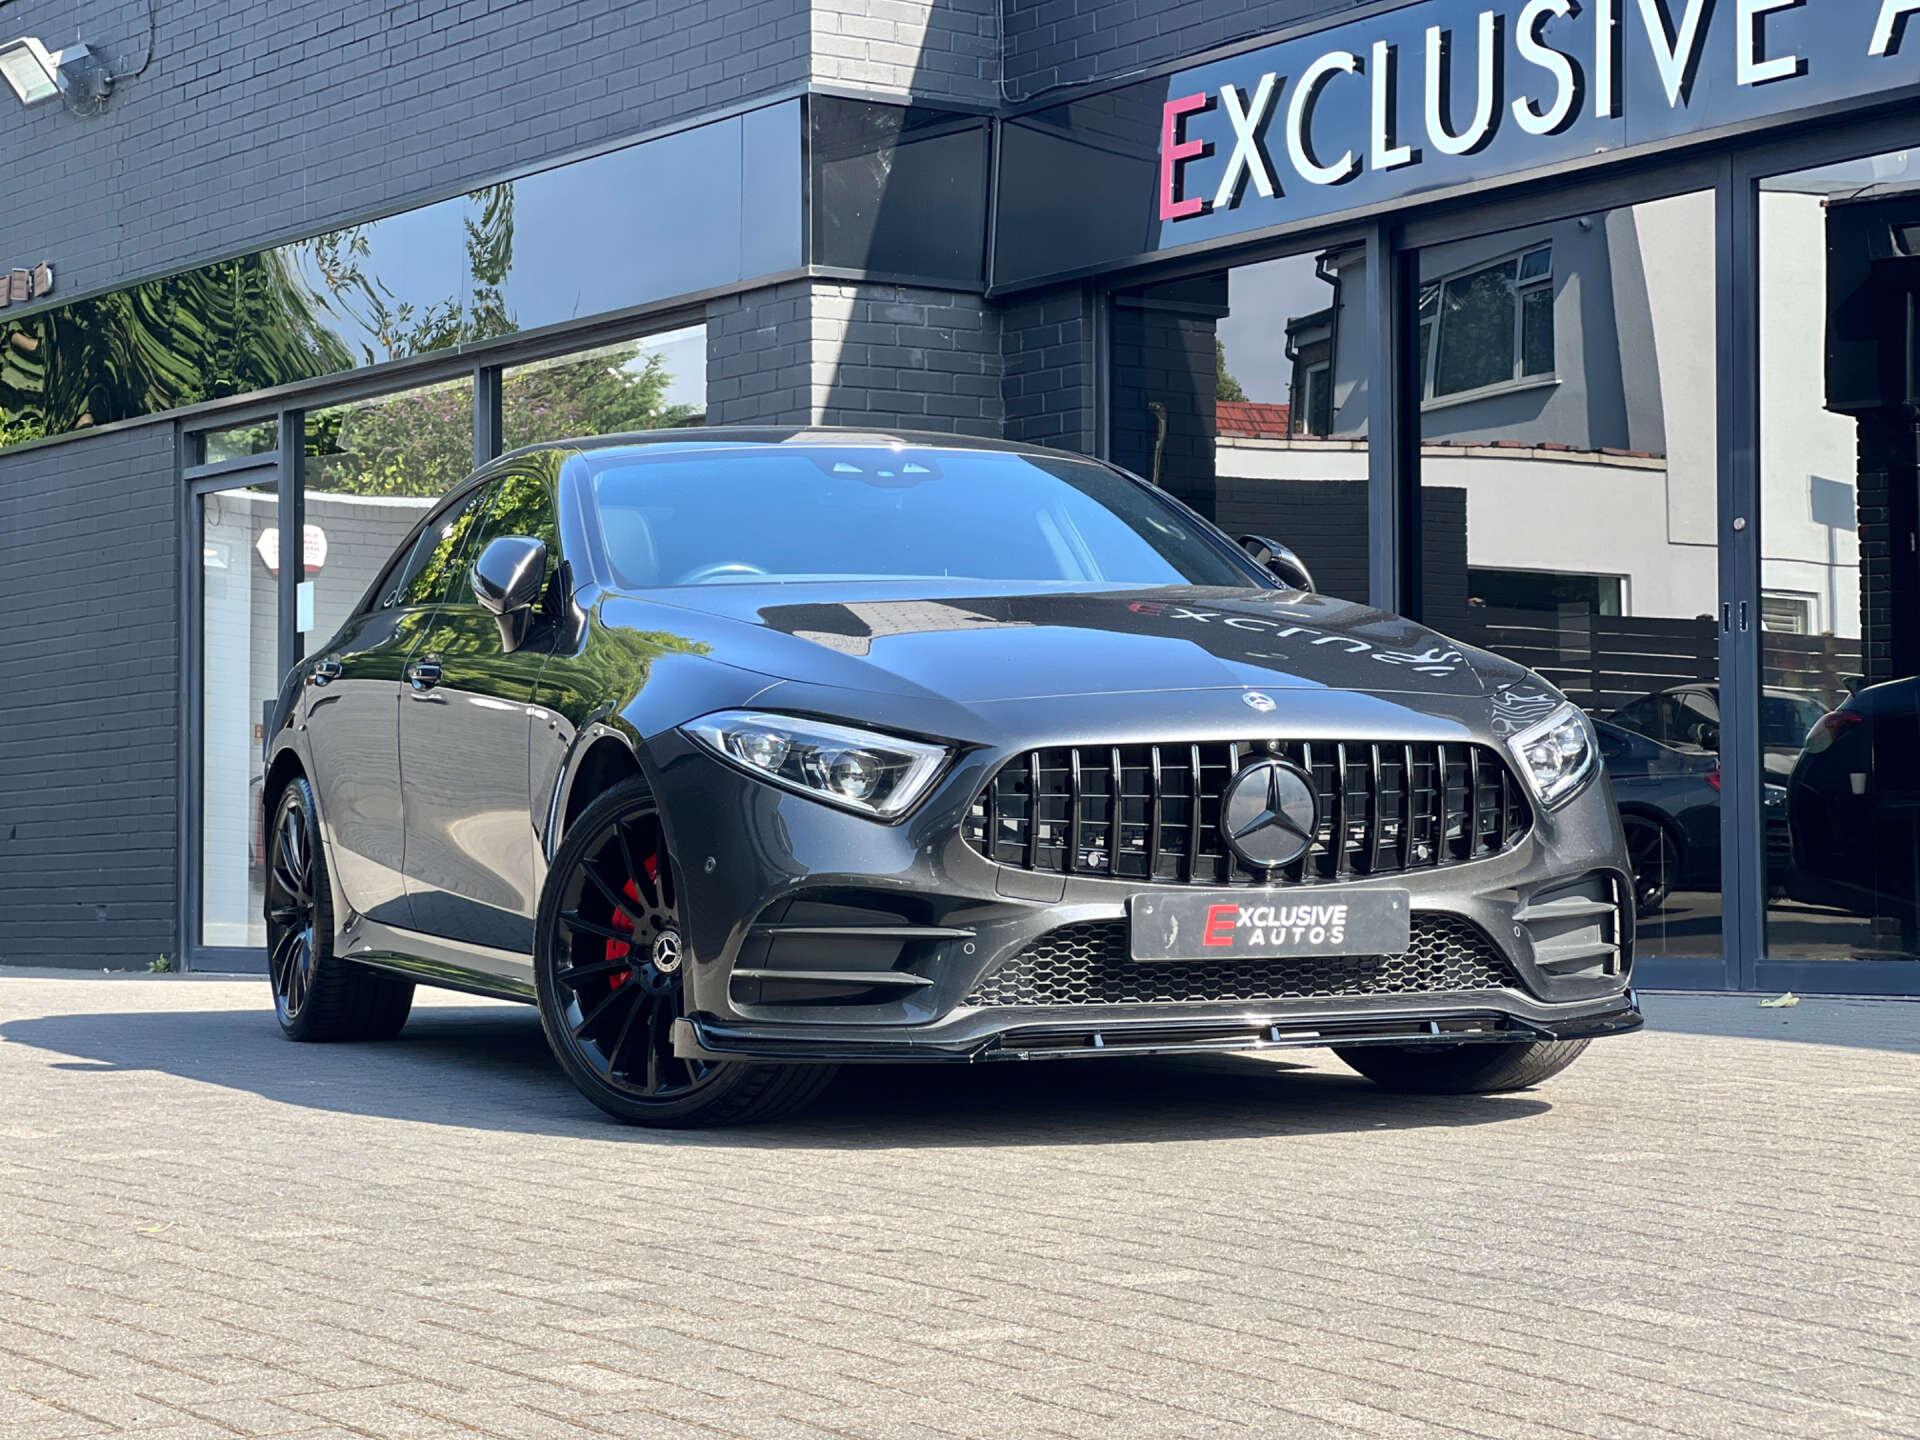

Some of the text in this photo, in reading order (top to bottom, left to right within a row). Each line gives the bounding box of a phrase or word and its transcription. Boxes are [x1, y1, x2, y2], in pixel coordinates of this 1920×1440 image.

[1159, 0, 1798, 221] EXCLUSIVE
[1202, 903, 1348, 947] EXCLUSIVE
[1248, 926, 1345, 946] AUTOS
